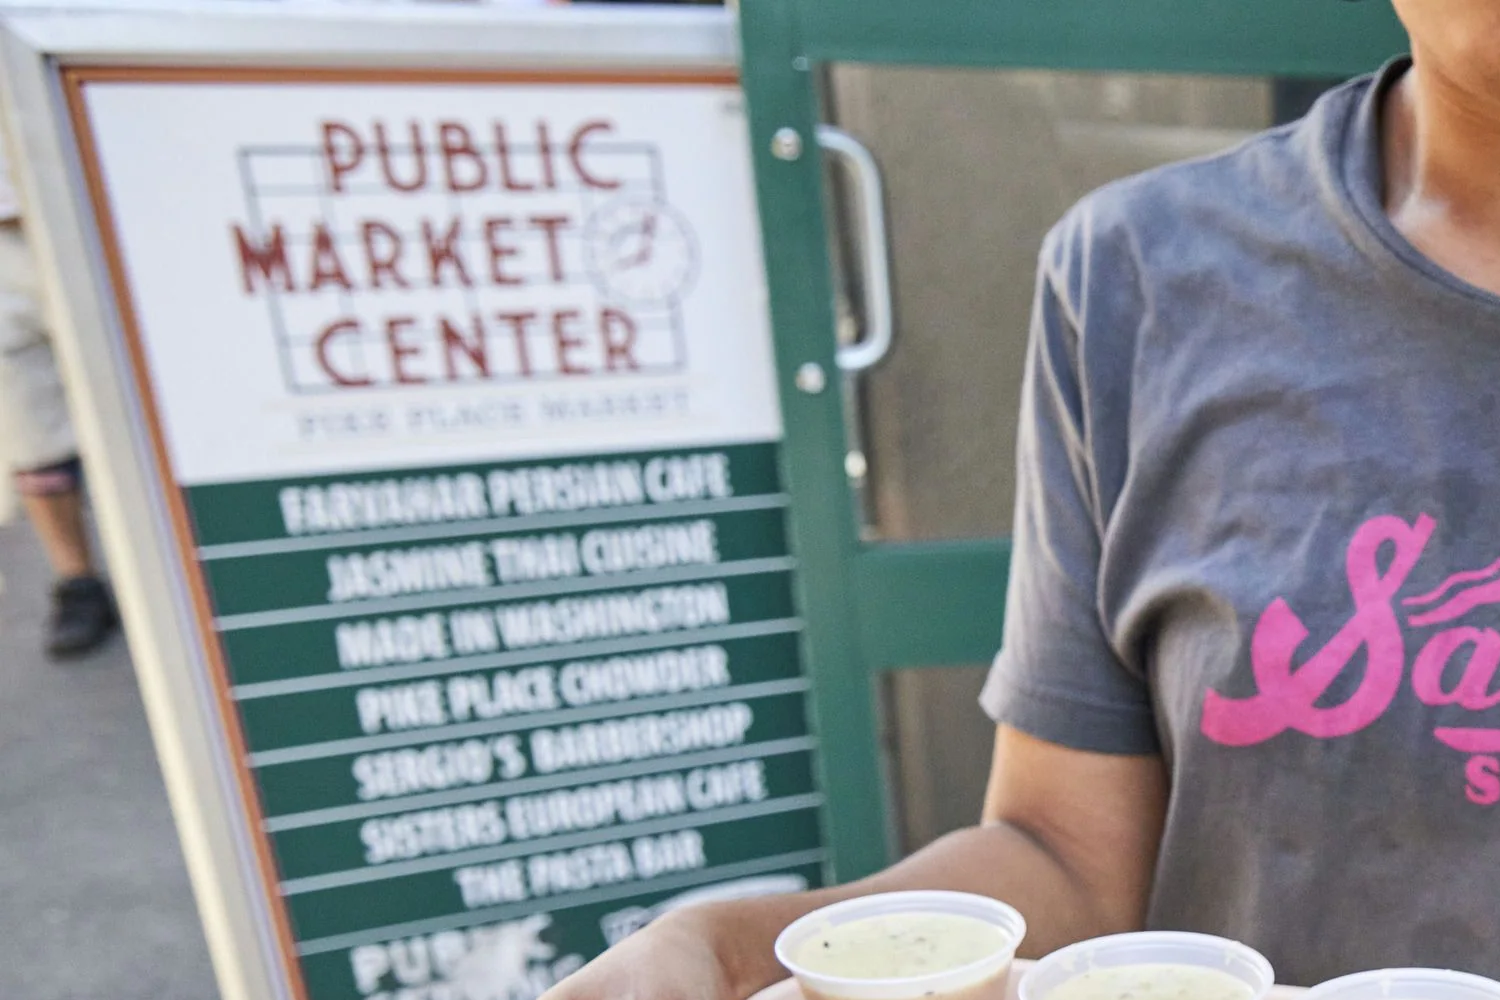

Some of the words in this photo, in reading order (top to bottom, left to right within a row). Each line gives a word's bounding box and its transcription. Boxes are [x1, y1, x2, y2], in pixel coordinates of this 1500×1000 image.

[319, 119, 623, 193] PUBLIC
[229, 214, 572, 295] MARKET
[314, 307, 641, 387] CENTER
[487, 460, 646, 516] PERSIAN
[644, 453, 733, 502] CAFE
[327, 540, 493, 603] JASMINE
[490, 532, 582, 581] THAI
[581, 519, 720, 575] CUISINE
[335, 611, 450, 670] MADE
[449, 608, 499, 656] IN
[499, 582, 731, 649] WASHINGTON
[355, 680, 446, 734] PIKE
[447, 665, 560, 722] PLACE
[559, 643, 731, 707] CHOWDER
[352, 734, 526, 801] SERGIO'S
[530, 702, 754, 774] BARBERSHOP
[360, 800, 506, 865] SISTERS
[505, 774, 686, 840] EUROPEAN
[685, 759, 768, 808] CAFE
[454, 859, 526, 910] THE
[527, 841, 634, 898] PASTA
[632, 829, 706, 880] BAR
